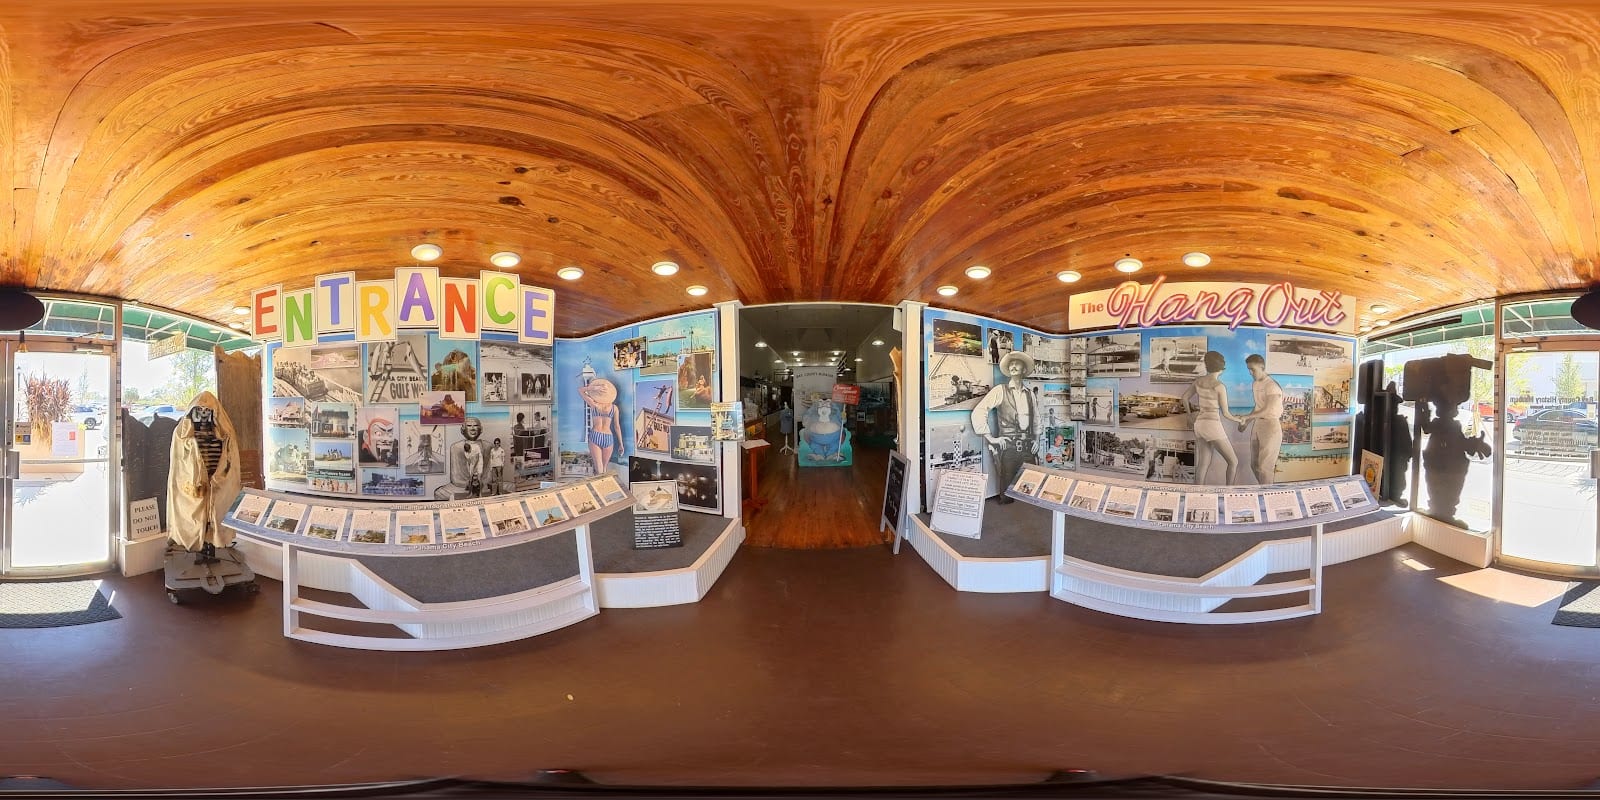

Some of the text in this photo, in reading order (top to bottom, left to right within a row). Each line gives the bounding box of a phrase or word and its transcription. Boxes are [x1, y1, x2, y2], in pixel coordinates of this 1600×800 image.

[255, 272, 549, 342] ENTRANCE
[1079, 275, 1346, 331] The Hang Out
[390, 383, 409, 399] GULF
[134, 504, 156, 513] PLEASE
[136, 525, 159, 534] TOUCH
[458, 540, 482, 548] Beach
